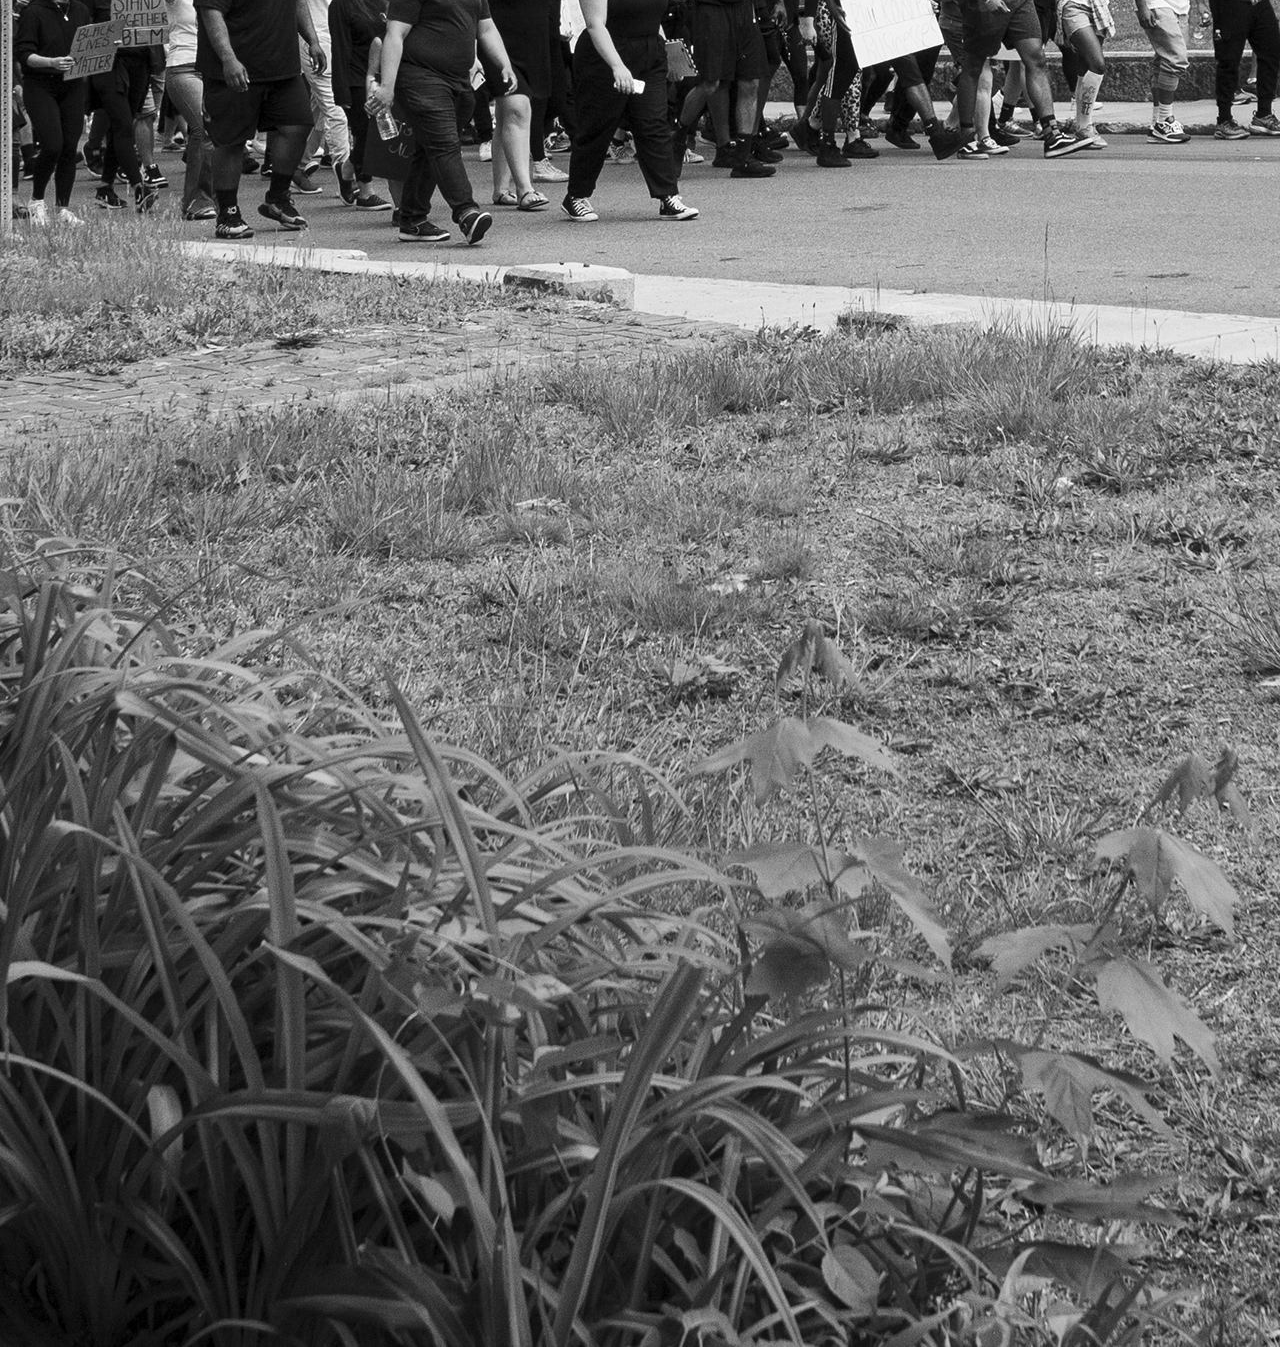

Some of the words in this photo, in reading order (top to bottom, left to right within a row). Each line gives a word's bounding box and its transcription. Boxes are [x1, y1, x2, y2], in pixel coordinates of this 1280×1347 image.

[113, 12, 169, 27] TOGETHER
[77, 24, 115, 42] BLACK
[122, 28, 164, 46] BLM
[77, 36, 110, 52] LIVES
[70, 54, 112, 75] MATTER
